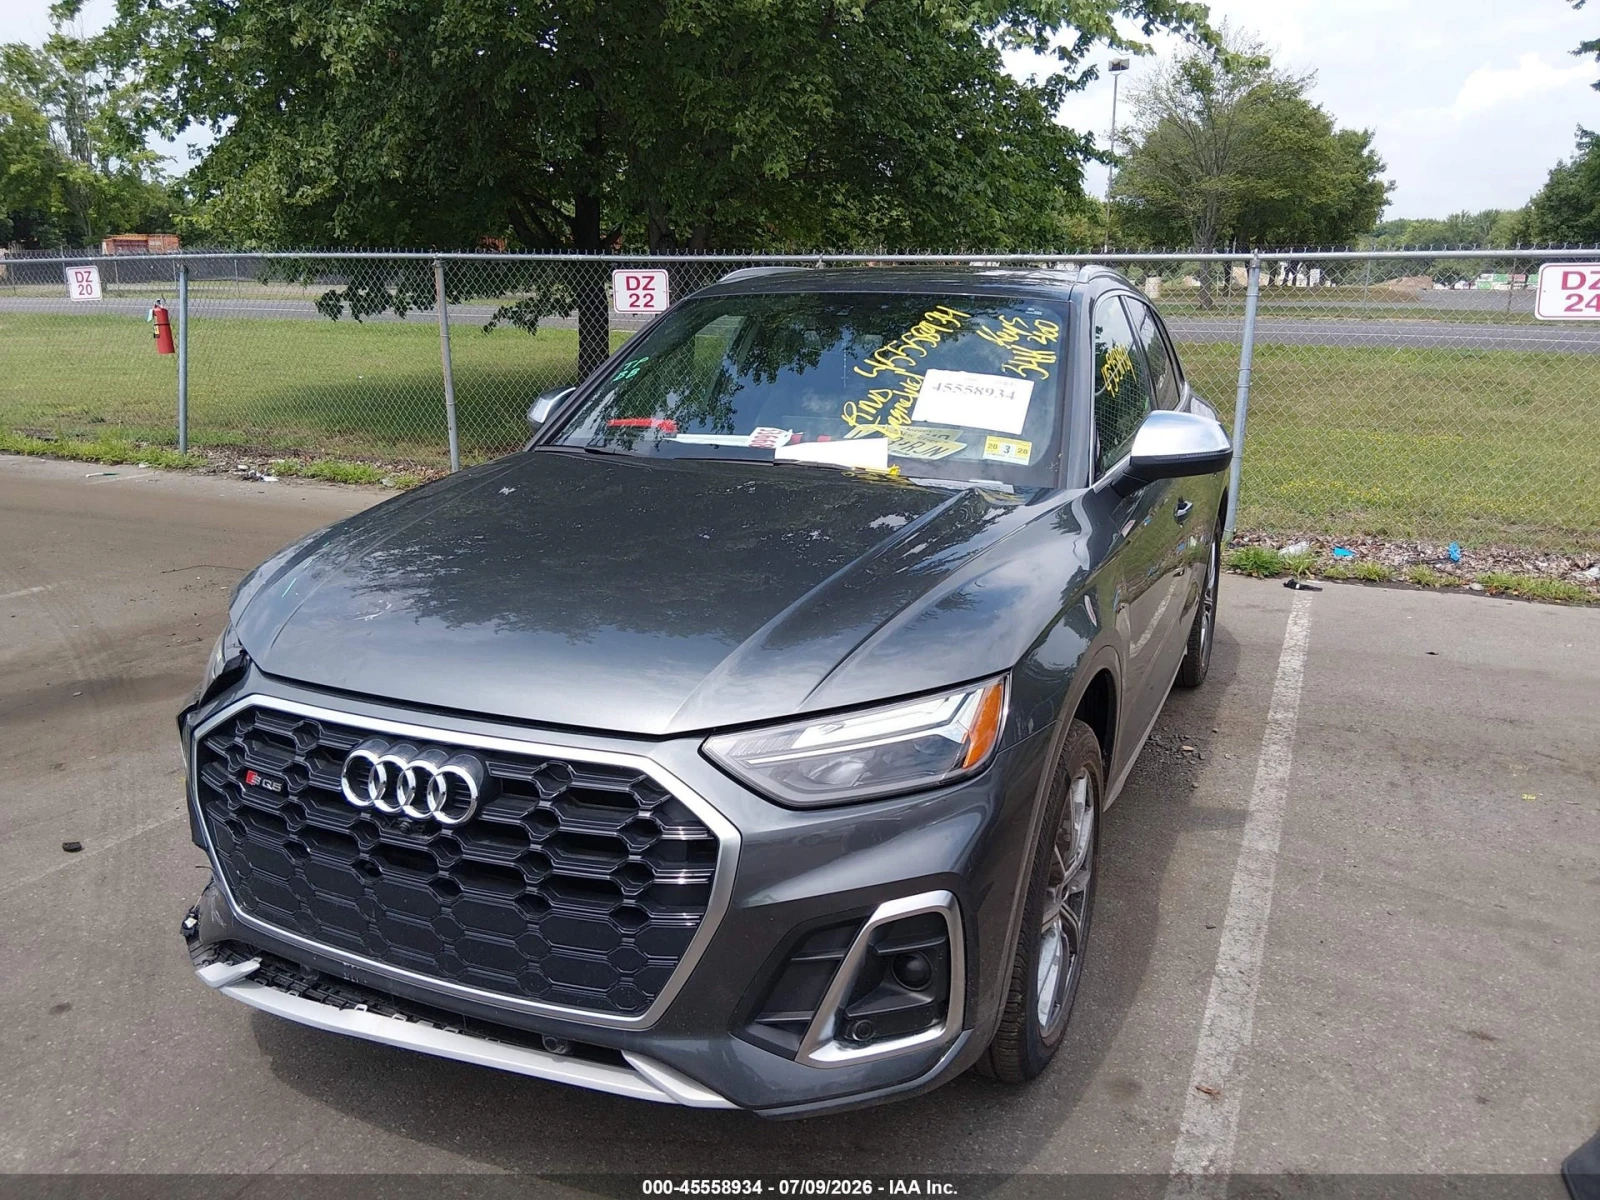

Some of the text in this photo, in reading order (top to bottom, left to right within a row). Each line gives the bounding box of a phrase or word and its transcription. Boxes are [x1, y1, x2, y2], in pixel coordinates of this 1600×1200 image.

[75, 271, 92, 283] DZ
[625, 275, 656, 291] DZ
[78, 284, 93, 295] 20
[629, 293, 655, 308] 22
[1563, 293, 1600, 312] 24
[932, 382, 1016, 400] 45558934
[1003, 445, 1011, 454] 3
